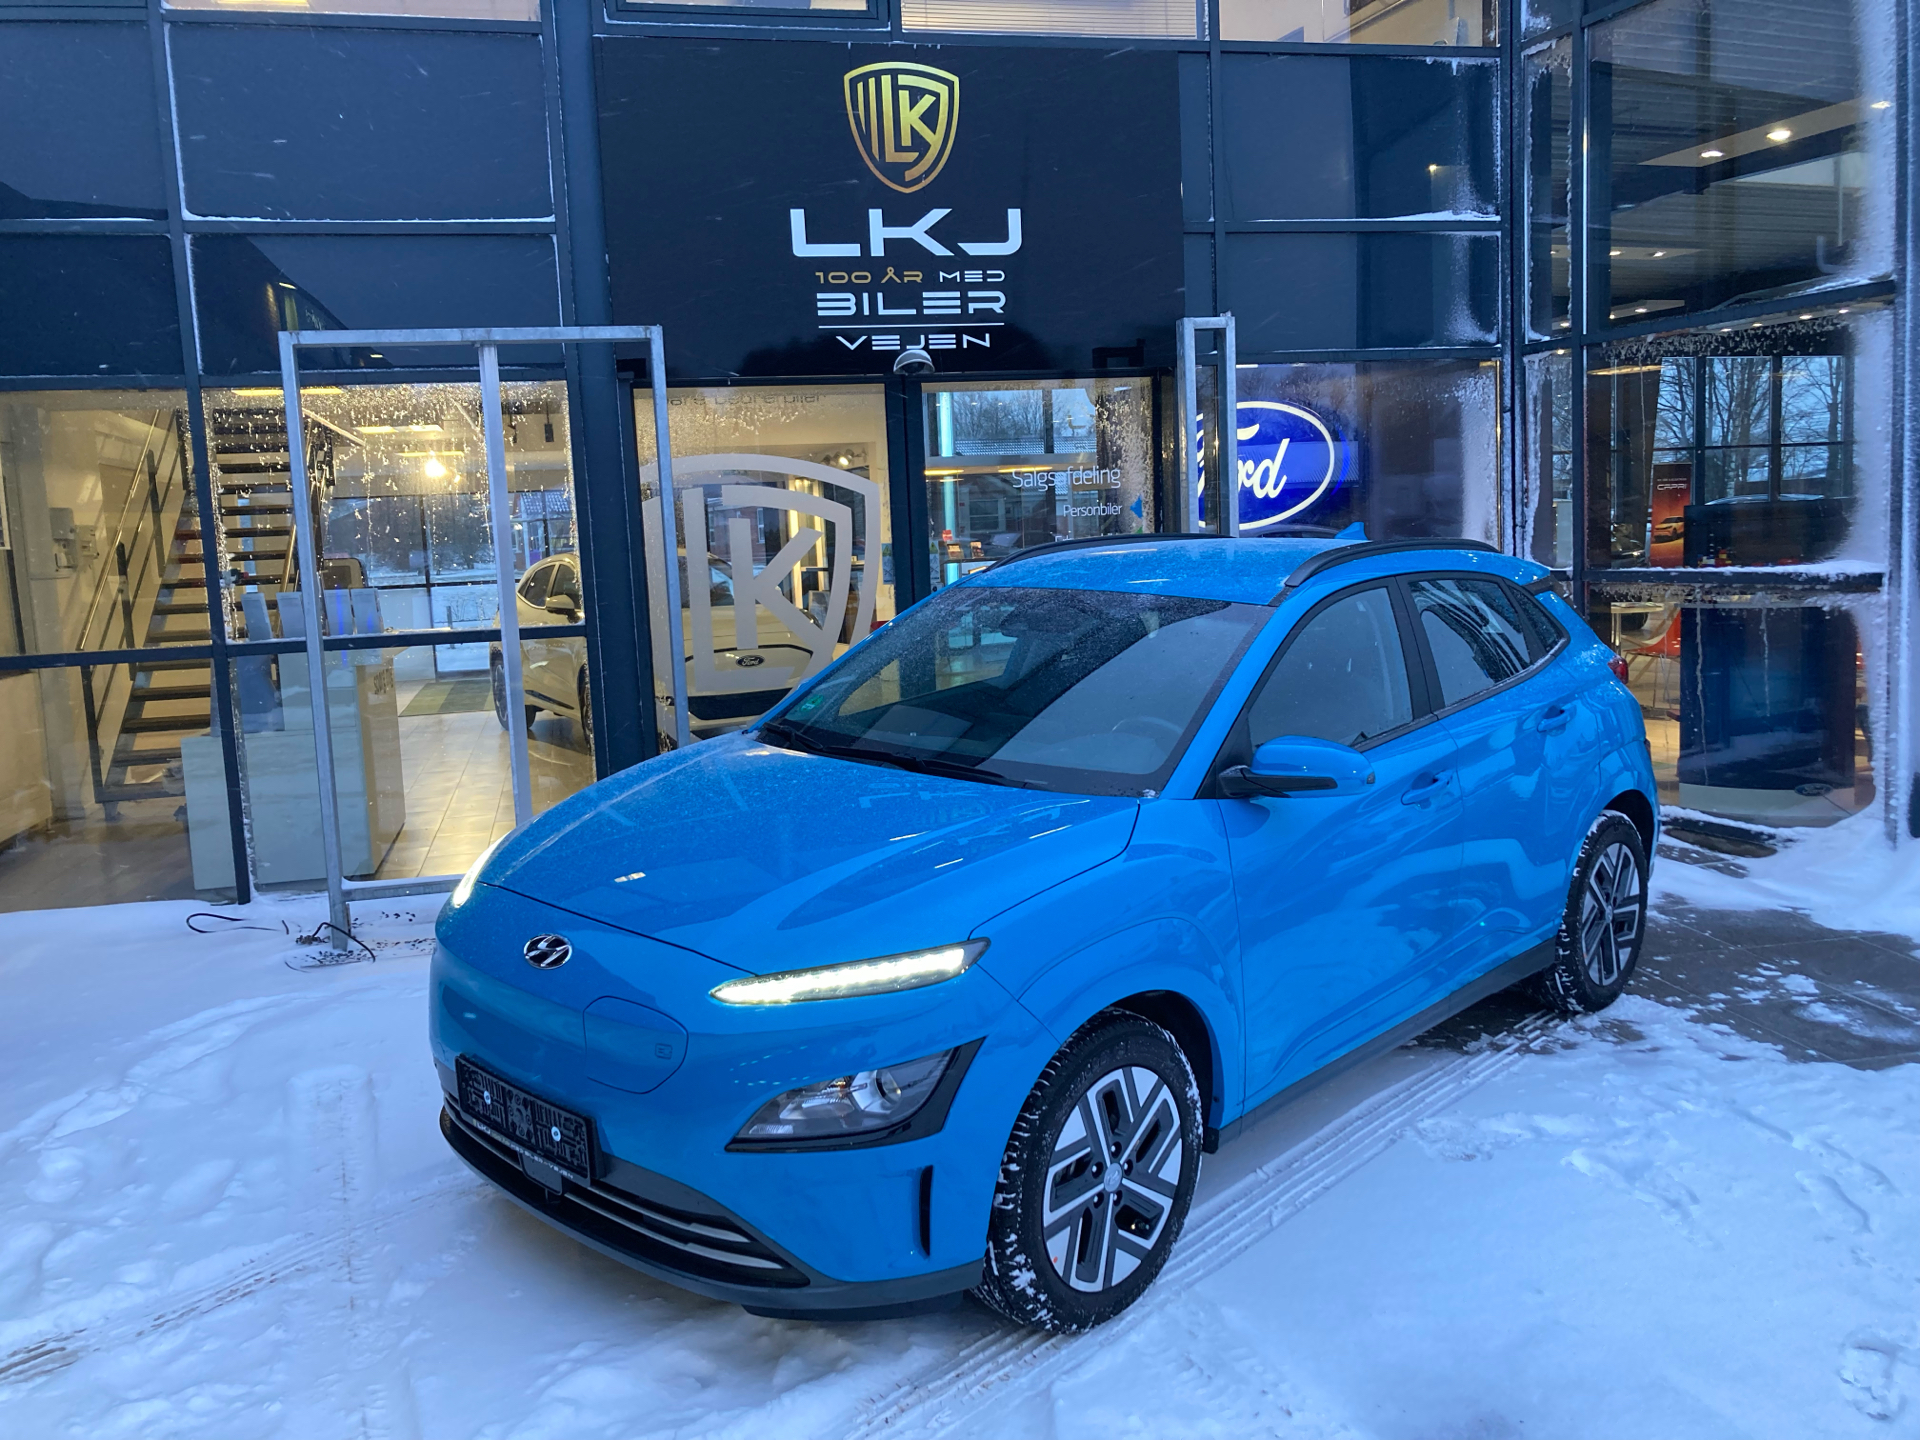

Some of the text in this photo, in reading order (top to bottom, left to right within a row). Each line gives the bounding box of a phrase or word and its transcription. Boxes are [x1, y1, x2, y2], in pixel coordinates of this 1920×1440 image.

[790, 208, 1022, 257] LKJ
[815, 266, 1005, 284] 100 ÅR MED
[816, 290, 1006, 316] BILER
[835, 333, 990, 350] VEJEN
[1012, 465, 1121, 492] Salgsafdeling
[1063, 502, 1122, 517] Personbiler
